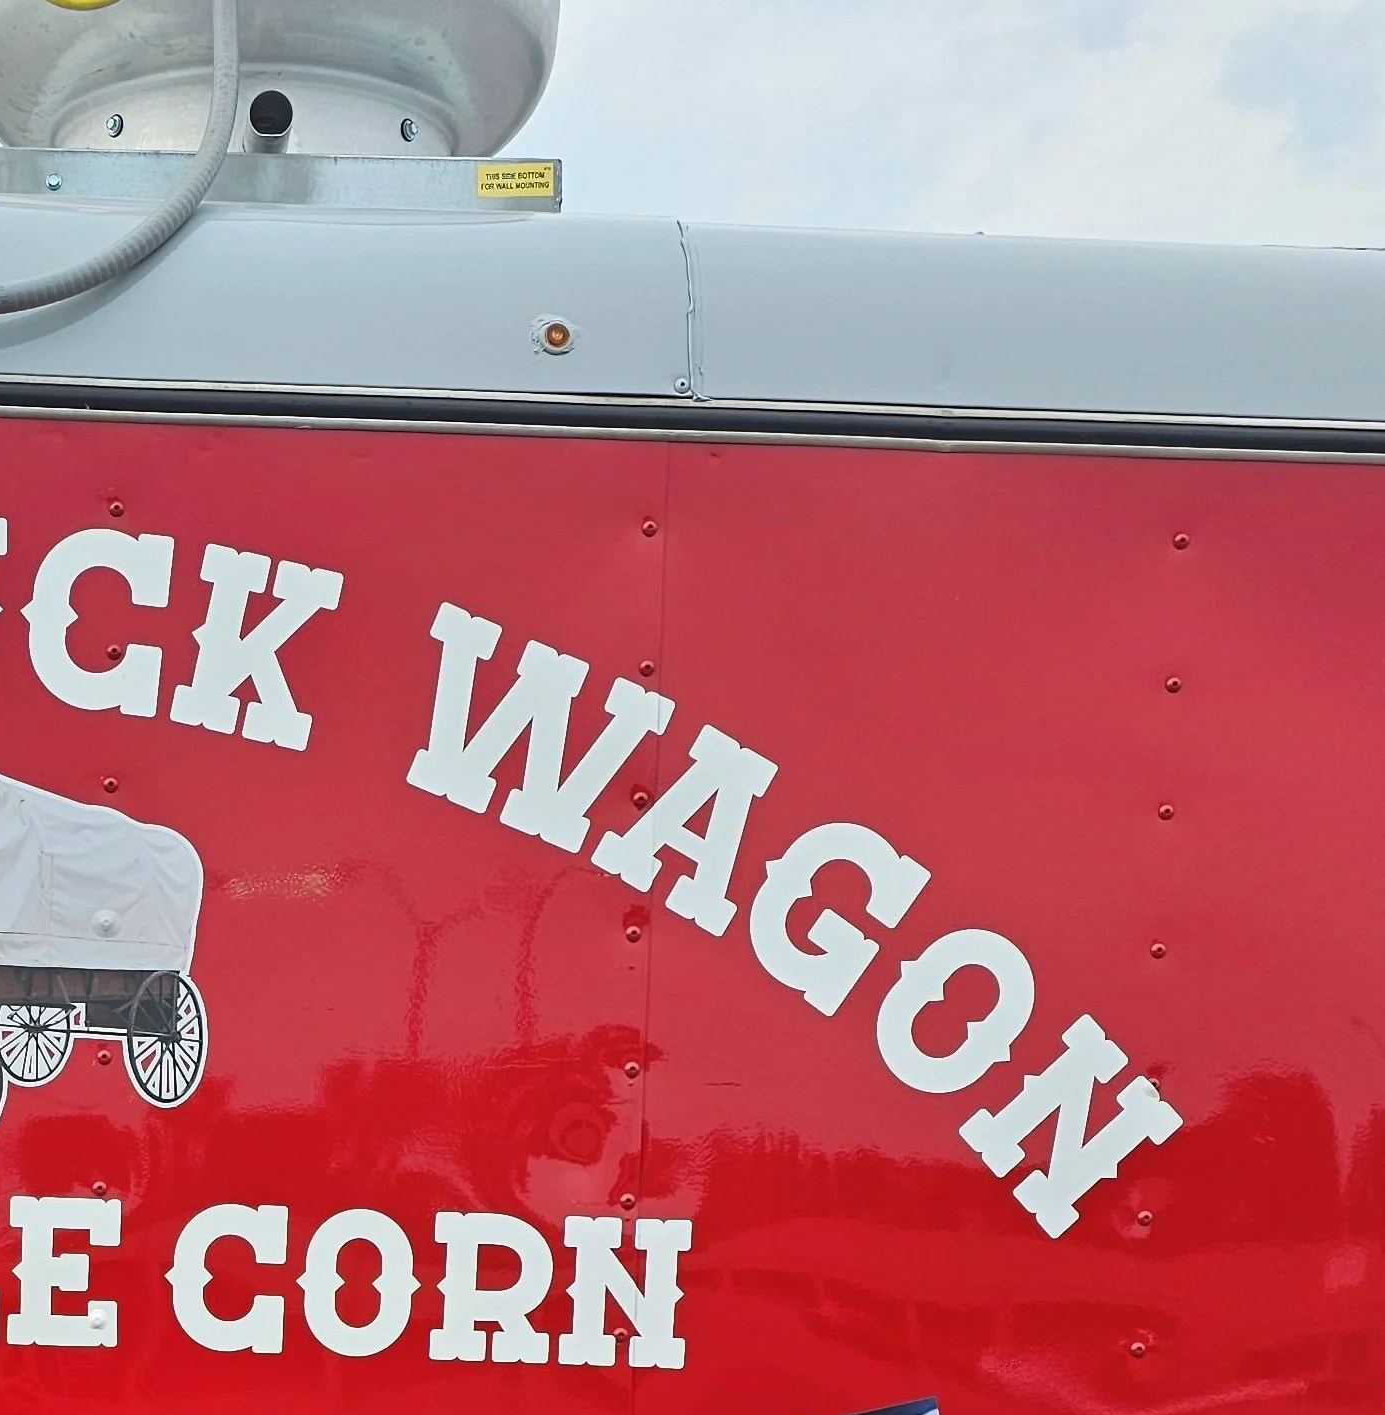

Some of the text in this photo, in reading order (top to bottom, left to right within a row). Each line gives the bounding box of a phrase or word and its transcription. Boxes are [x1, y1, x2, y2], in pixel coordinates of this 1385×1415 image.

[496, 182, 514, 190] WALL
[515, 181, 550, 189] MOUNTING
[517, 171, 545, 180] BOTTOM
[406, 602, 1183, 1239] WAGON
[165, 1204, 692, 1369] CORN
